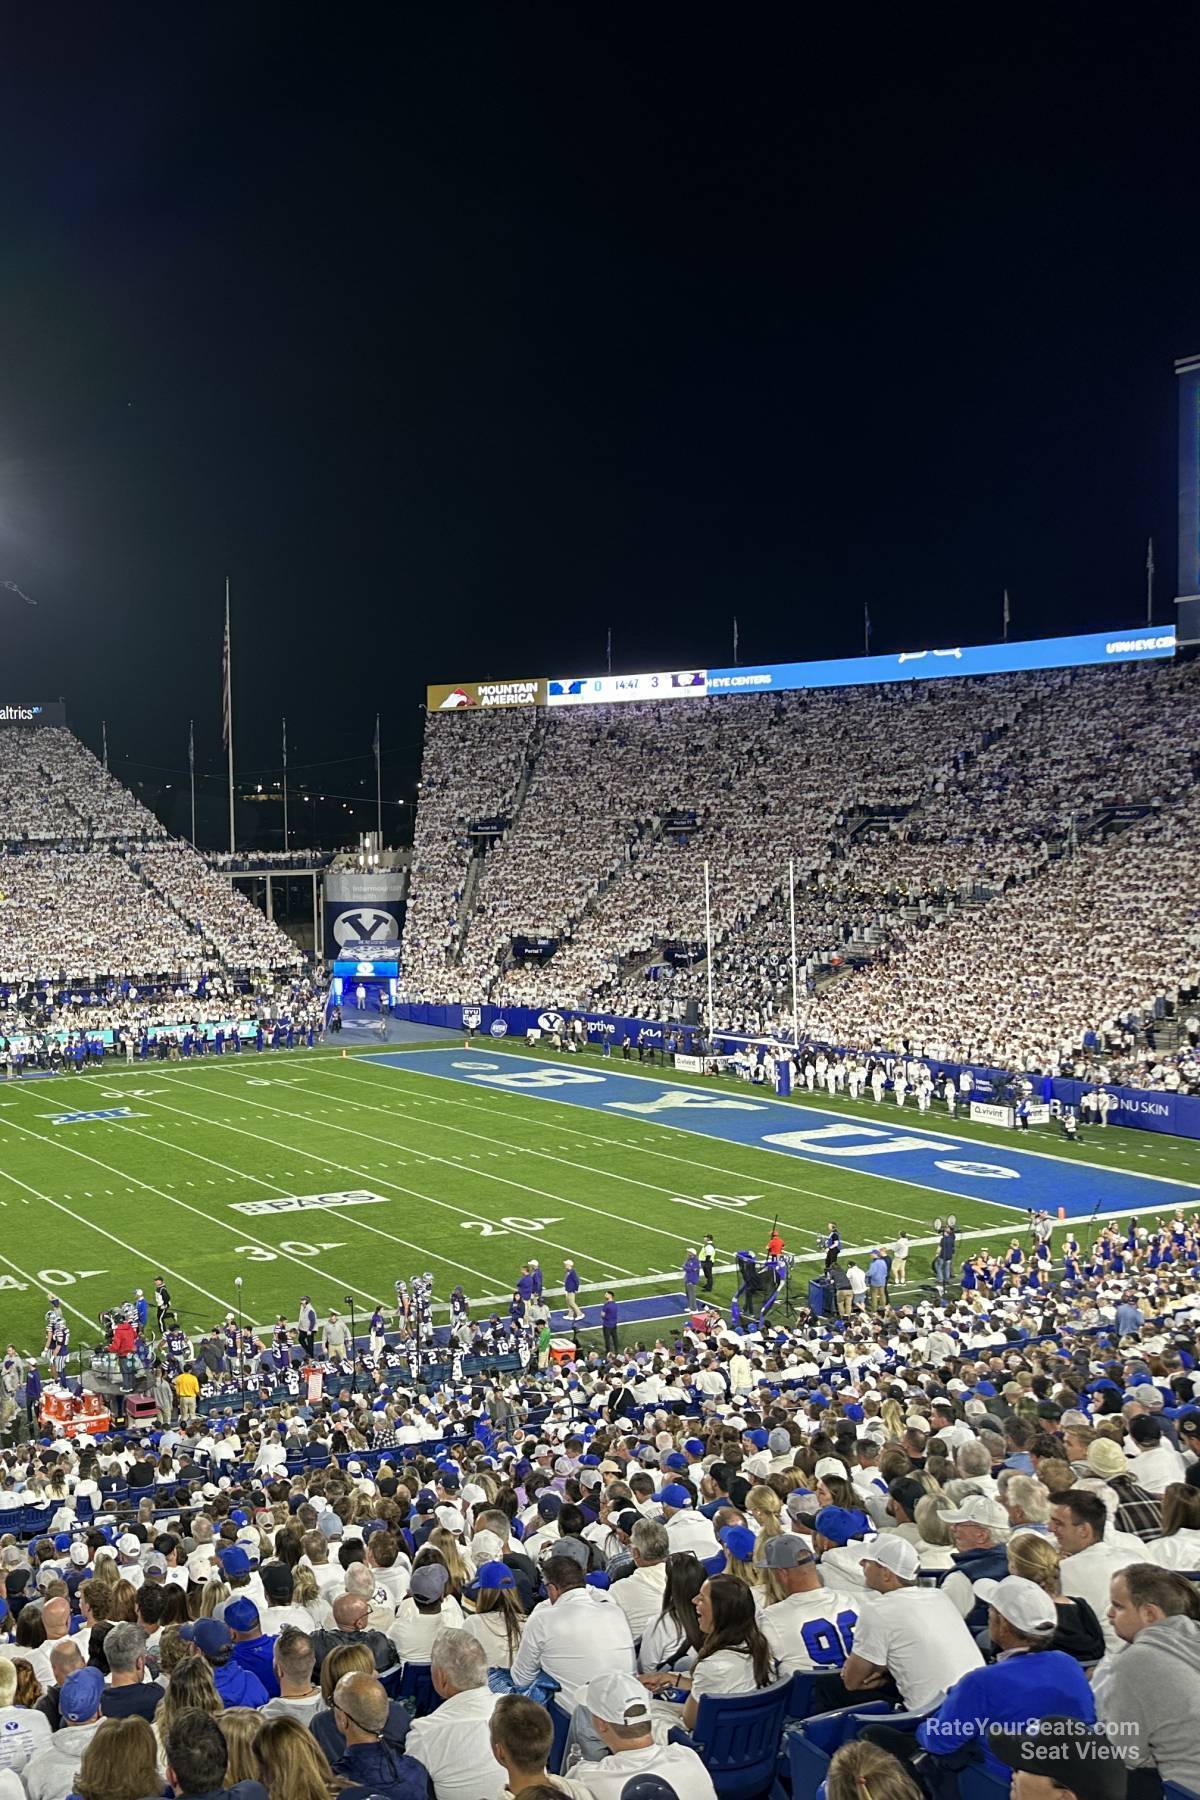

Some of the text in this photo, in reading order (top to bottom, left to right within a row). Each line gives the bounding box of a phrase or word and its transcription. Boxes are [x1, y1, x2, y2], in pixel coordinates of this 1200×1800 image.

[615, 679, 639, 690] 14:47
[651, 676, 659, 688] 3
[712, 678, 731, 688] EYE
[731, 675, 772, 687] CENTERS
[478, 682, 538, 696] MOUNTAIN
[481, 694, 535, 706] AMERICA
[1120, 1097, 1168, 1116] NU SKIN
[270, 1190, 377, 1213] PACS
[669, 1194, 748, 1210] 10
[459, 1216, 545, 1237] 20
[234, 1241, 321, 1262] 30
[171, 1340, 182, 1349] 91
[497, 1343, 509, 1355] 19
